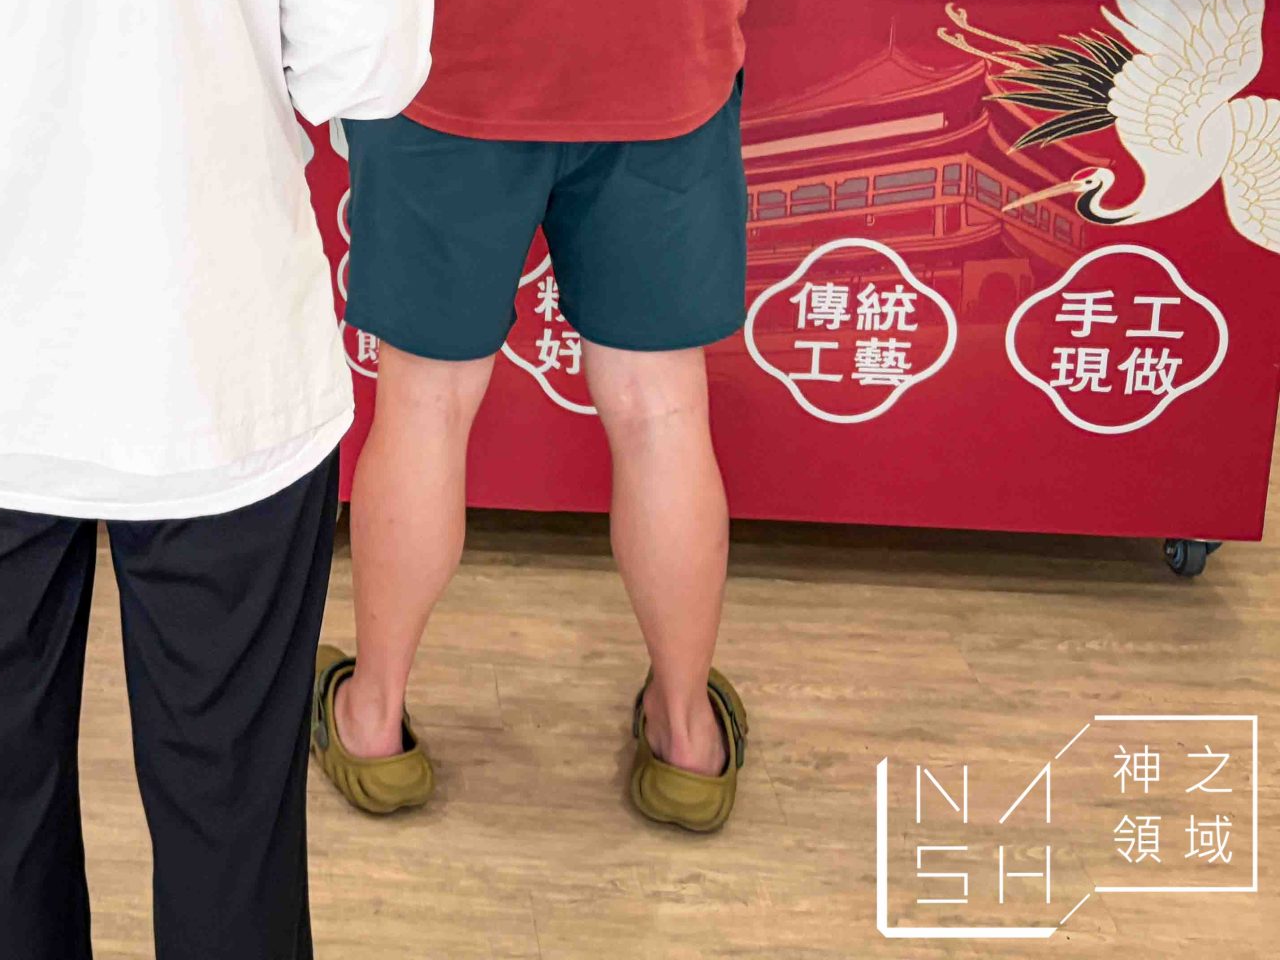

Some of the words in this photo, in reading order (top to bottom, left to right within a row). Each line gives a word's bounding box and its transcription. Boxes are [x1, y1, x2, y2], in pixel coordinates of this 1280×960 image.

[789, 282, 919, 333] 傳統
[1055, 290, 1186, 340] 手工
[787, 337, 914, 388] 工藝
[1050, 346, 1184, 396] 現做
